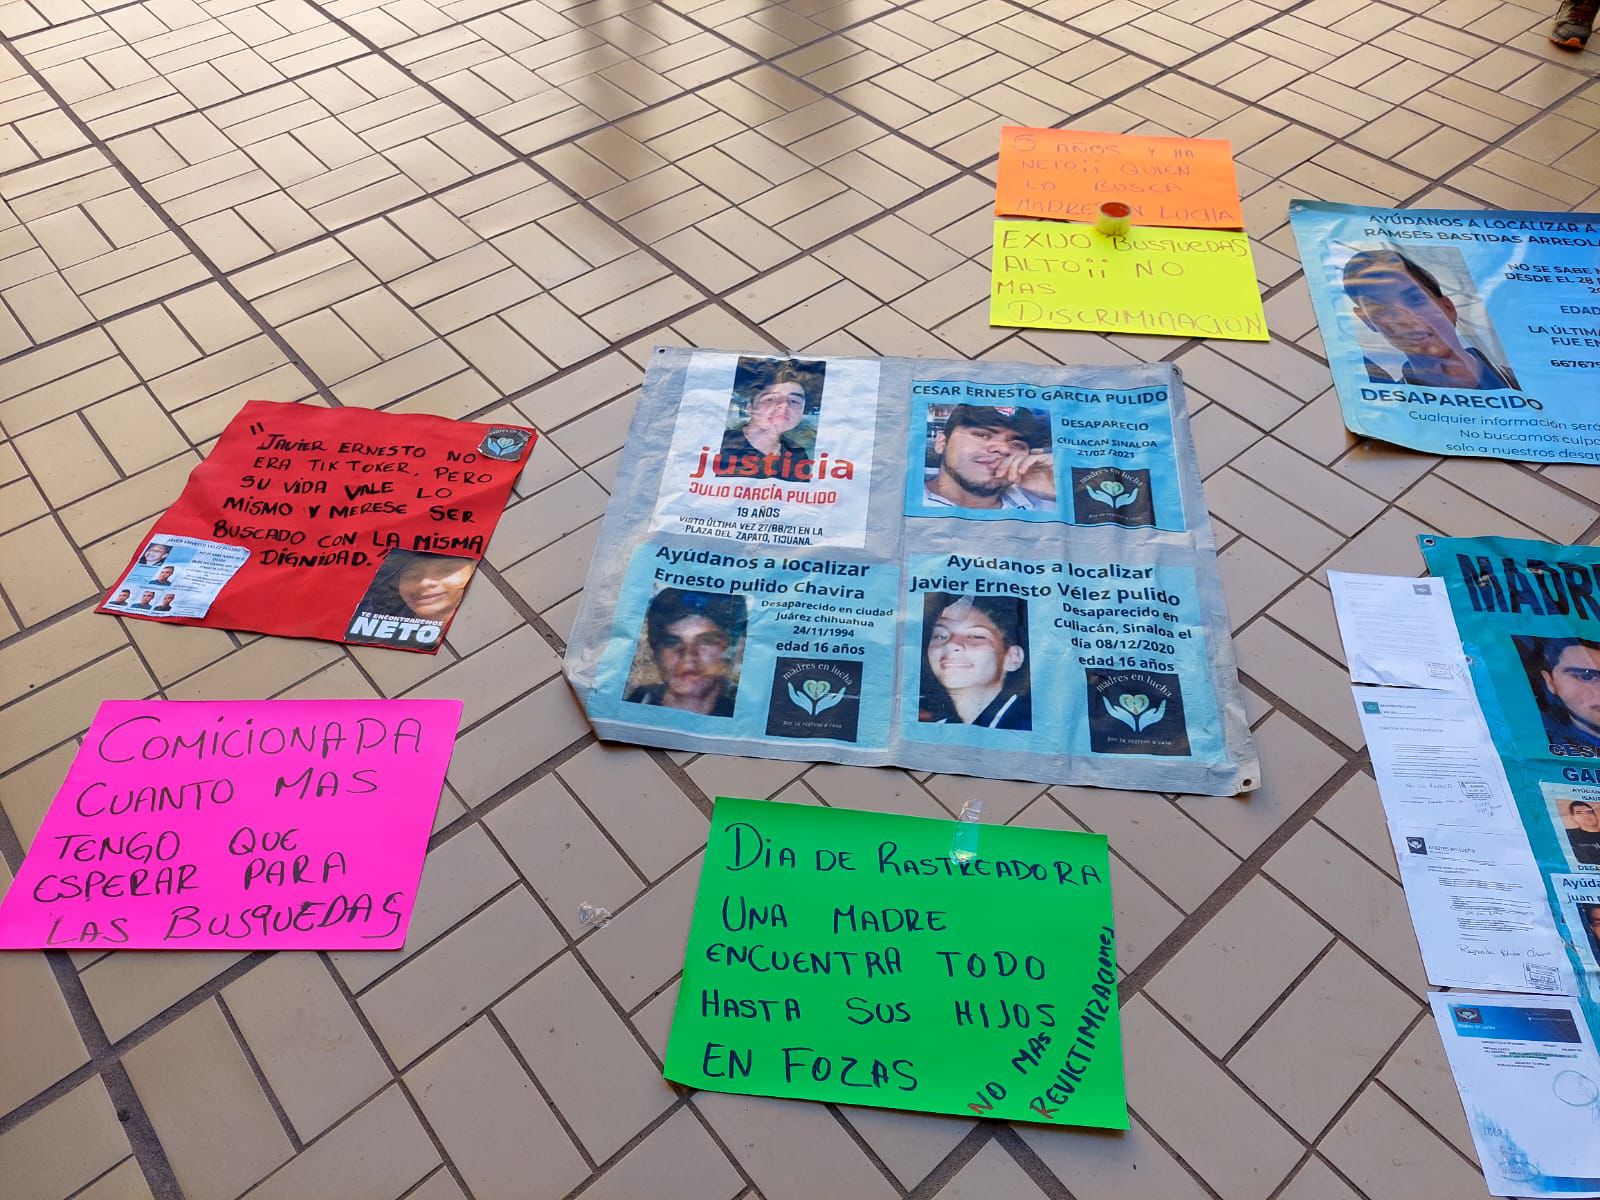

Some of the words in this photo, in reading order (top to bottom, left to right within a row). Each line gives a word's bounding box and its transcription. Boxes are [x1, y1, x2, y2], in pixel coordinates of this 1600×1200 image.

[1013, 134, 1036, 152] 5
[1094, 182, 1182, 194] BUSCA
[1160, 206, 1235, 223] LUCHA
[1369, 213, 1463, 228] AYÚDANOS
[1468, 218, 1481, 228] A
[1484, 218, 1580, 233] LOCALIZAR
[1584, 223, 1597, 233] A
[1002, 230, 1092, 249] EXIJO
[1105, 234, 1248, 257] BUSQUEDAS
[1437, 231, 1522, 244] BASTIDAS
[1136, 260, 1184, 277] NO
[1504, 272, 1552, 283] DESDE
[1556, 275, 1575, 283] EL
[1508, 263, 1530, 271] NO
[1533, 265, 1551, 273] SE
[1554, 266, 1592, 275] SABE
[997, 279, 1057, 296] MAS
[1007, 299, 1263, 335] DISCRIMINACION
[1560, 305, 1600, 316] EDAD
[1528, 325, 1549, 334] LA
[1551, 336, 1582, 347] FUE
[912, 384, 961, 396] CESAR
[966, 386, 1037, 399] ERNESTO
[1042, 390, 1100, 404] GARCIA
[1105, 390, 1168, 406] PULIDO
[1360, 388, 1543, 411] DESAPARECIDO
[1061, 418, 1149, 431] DESAPARECIO
[1408, 410, 1477, 425] Cualquier
[1481, 415, 1567, 430] información
[1057, 437, 1109, 447] CULIACAN
[1111, 439, 1158, 449] SINALOA
[1460, 429, 1480, 439] No
[1484, 430, 1560, 443] buscamos
[338, 442, 427, 458] ERNESTO
[447, 451, 476, 464] NO
[1446, 443, 1475, 452] solo
[1492, 446, 1555, 458] nuestros
[253, 457, 291, 471] ERA
[434, 466, 493, 484] PERO
[689, 446, 855, 481] justicia
[240, 475, 271, 490] SU
[283, 476, 328, 495] VIDA
[344, 481, 395, 500] VALE
[416, 488, 453, 499] LO
[689, 481, 730, 498] JULIO
[733, 484, 782, 501] GARCÍA
[786, 490, 837, 504] PULIDO
[223, 496, 293, 516] MISMO
[329, 502, 408, 519] MERESE
[429, 505, 476, 523] SER
[737, 507, 749, 517] 19
[751, 506, 780, 518] AÑOS
[212, 519, 306, 545] BUSCADO
[317, 531, 357, 548] CON
[372, 530, 400, 548] LA
[412, 532, 484, 554] MISMA
[680, 516, 704, 526] VISTO
[707, 517, 737, 529] ÚLTIMA
[740, 523, 757, 531] VEZ
[799, 527, 811, 535] EN
[812, 527, 823, 536] LA
[685, 524, 713, 535] PLAZA
[715, 529, 731, 538] DEL
[735, 531, 770, 543] ZAPATO,
[773, 534, 813, 545] TIJUANA.
[655, 545, 758, 570] Ayúdanos
[763, 558, 776, 570] a
[782, 558, 870, 577] localizar
[947, 554, 1045, 575] Ayúdanos
[1052, 563, 1063, 573] a
[1068, 562, 1153, 580] localizar
[654, 567, 725, 589] Ernesto
[730, 577, 788, 594] pulido
[793, 581, 865, 600] Chavira
[909, 576, 969, 593] Javier
[975, 578, 1052, 597] Ernesto
[1057, 582, 1110, 601] Vélez
[1117, 586, 1181, 606] pulido
[761, 599, 836, 613] Desaparecido
[839, 606, 853, 615] en
[855, 606, 894, 618] ciudad
[774, 611, 812, 624] Juárez
[814, 614, 875, 628] chihuahua
[1062, 602, 1160, 620] Desaparecido
[1162, 611, 1179, 623] en
[349, 616, 440, 643] NETO
[792, 625, 855, 638] 24/11/1994
[1054, 618, 1120, 635] Culiacán,
[1122, 623, 1175, 639] Sinaloa
[1178, 628, 1192, 640] el
[775, 640, 809, 653] edad
[813, 642, 828, 653] 16
[832, 642, 866, 656] años
[1071, 636, 1092, 650] día
[1095, 639, 1175, 655] 08/12/2020
[782, 662, 816, 680] madres
[818, 663, 830, 671] en
[830, 664, 853, 686] lucha
[1078, 655, 1115, 668] edad
[1118, 656, 1136, 668] 16
[1140, 657, 1175, 672] años
[1096, 673, 1129, 692] madres
[1131, 673, 1144, 681] en
[1146, 675, 1173, 698] lucha
[98, 715, 424, 763] COMICIONADA
[76, 778, 235, 818] CUANTO
[274, 766, 378, 800] MAS
[54, 830, 181, 863] TENGO
[228, 827, 300, 856] QUE
[723, 821, 796, 872] DIA
[815, 849, 857, 872] DE
[878, 841, 1103, 885] RASTREADORA
[33, 864, 200, 904] ESPERAR
[243, 852, 347, 891] PARA
[45, 911, 130, 945] LAS
[164, 891, 405, 942] BUSQUEDAS
[721, 896, 789, 932] UNA
[833, 904, 948, 935] MADRE
[705, 942, 901, 978] ENCUENTRA
[936, 951, 1046, 981] TODO
[701, 989, 801, 1021] HASTA
[846, 997, 912, 1025] SUS
[955, 1000, 1057, 1029] HIJOS
[702, 1042, 752, 1078] EN
[781, 1046, 918, 1091] FOZAS
[967, 1081, 1007, 1115] NO
[1011, 1031, 1052, 1075] MAS
